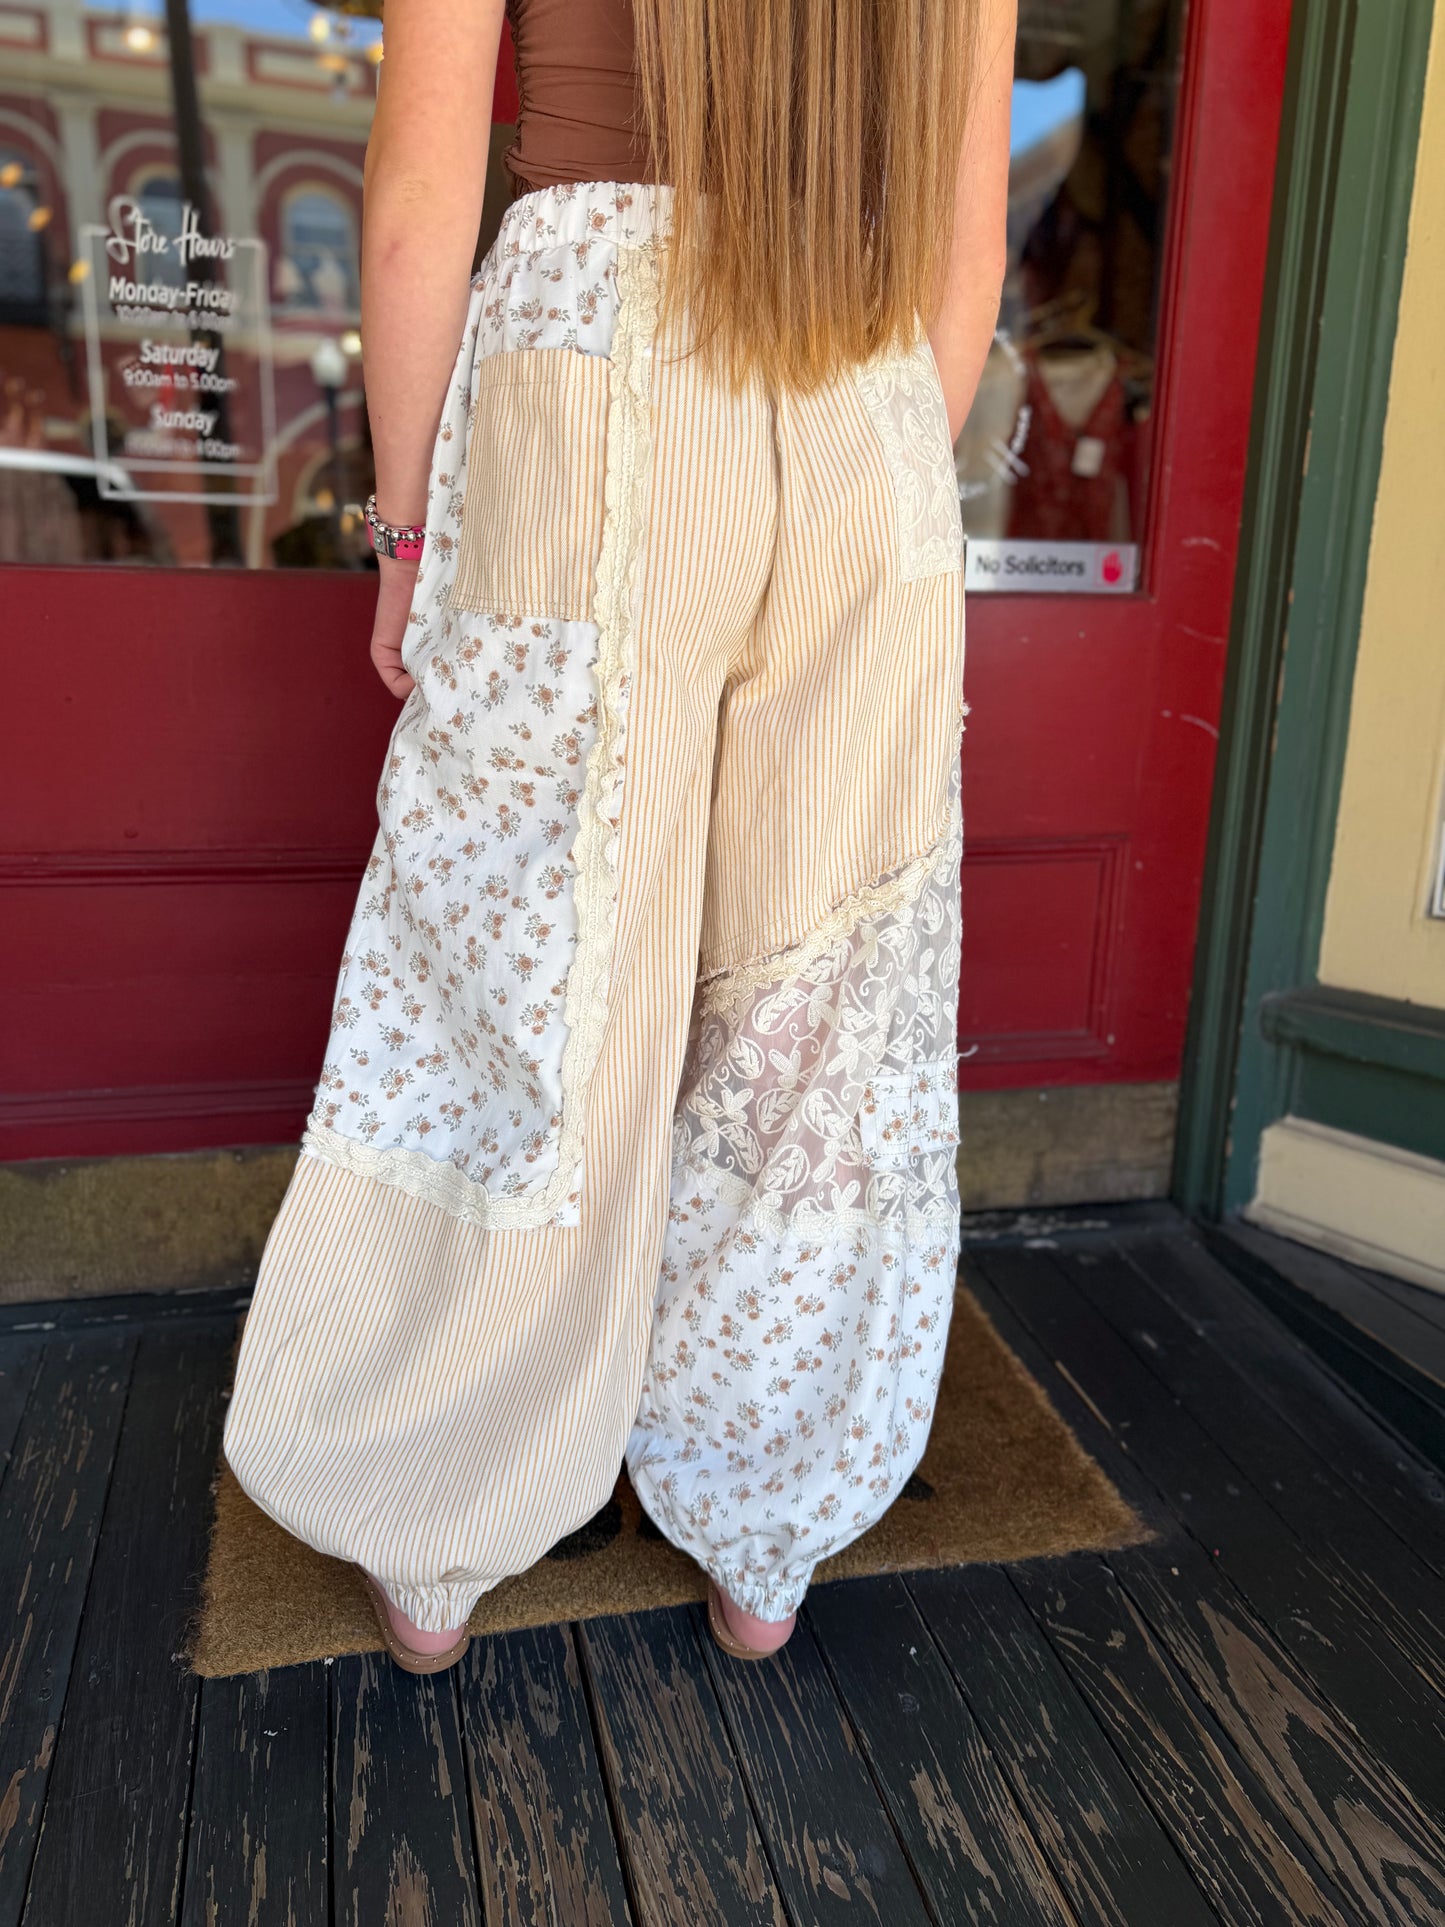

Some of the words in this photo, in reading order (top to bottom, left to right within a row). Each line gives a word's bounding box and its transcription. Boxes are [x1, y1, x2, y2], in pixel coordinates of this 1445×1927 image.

[106, 195, 168, 265] Store
[173, 204, 234, 266] Hours
[110, 276, 239, 308] Monday-Friday
[140, 341, 218, 371] Saturday
[123, 368, 172, 387] 9:00am
[174, 372, 189, 389] to
[151, 406, 217, 435] Sunday
[976, 555, 1000, 573] No
[1005, 555, 1085, 576] Solicitors
